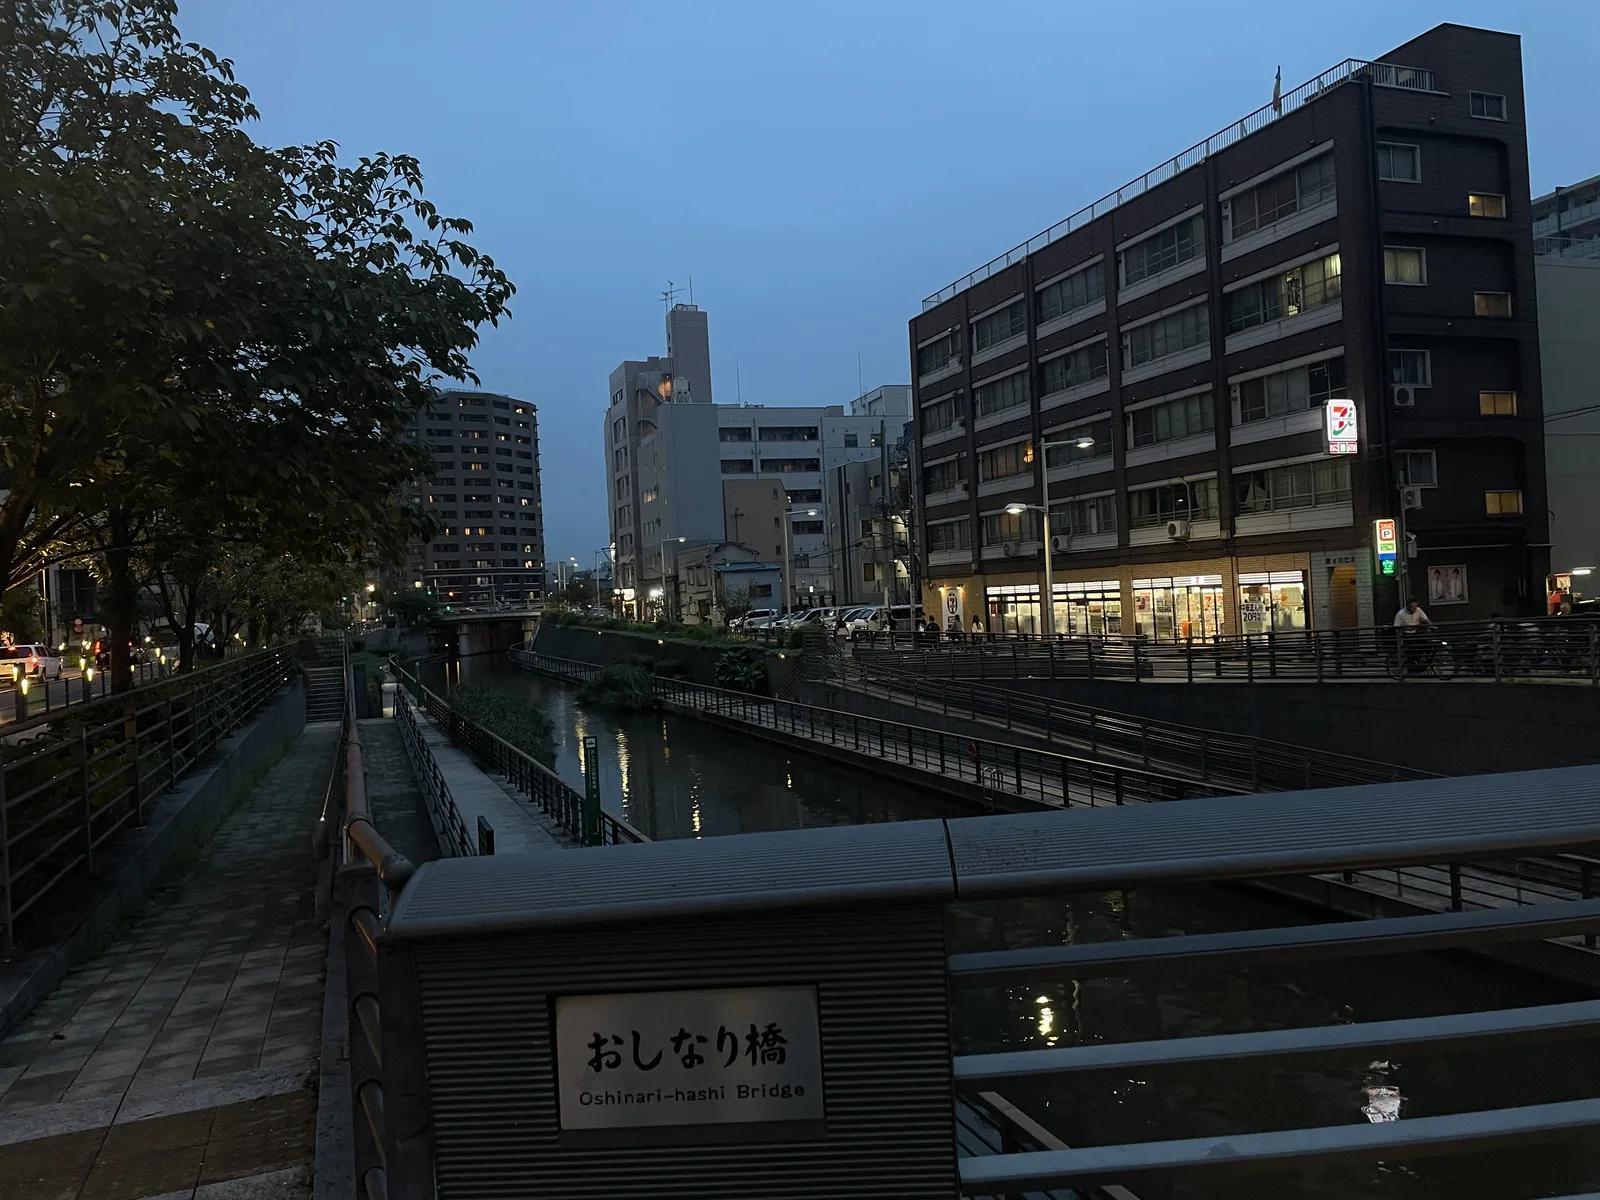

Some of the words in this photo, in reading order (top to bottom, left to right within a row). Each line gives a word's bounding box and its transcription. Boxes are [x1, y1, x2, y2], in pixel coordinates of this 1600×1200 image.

[1383, 530, 1391, 538] P
[587, 1022, 788, 1073] おしなり橋
[580, 1085, 725, 1106] Oshinari-hashi
[737, 1083, 805, 1100] Bridge
